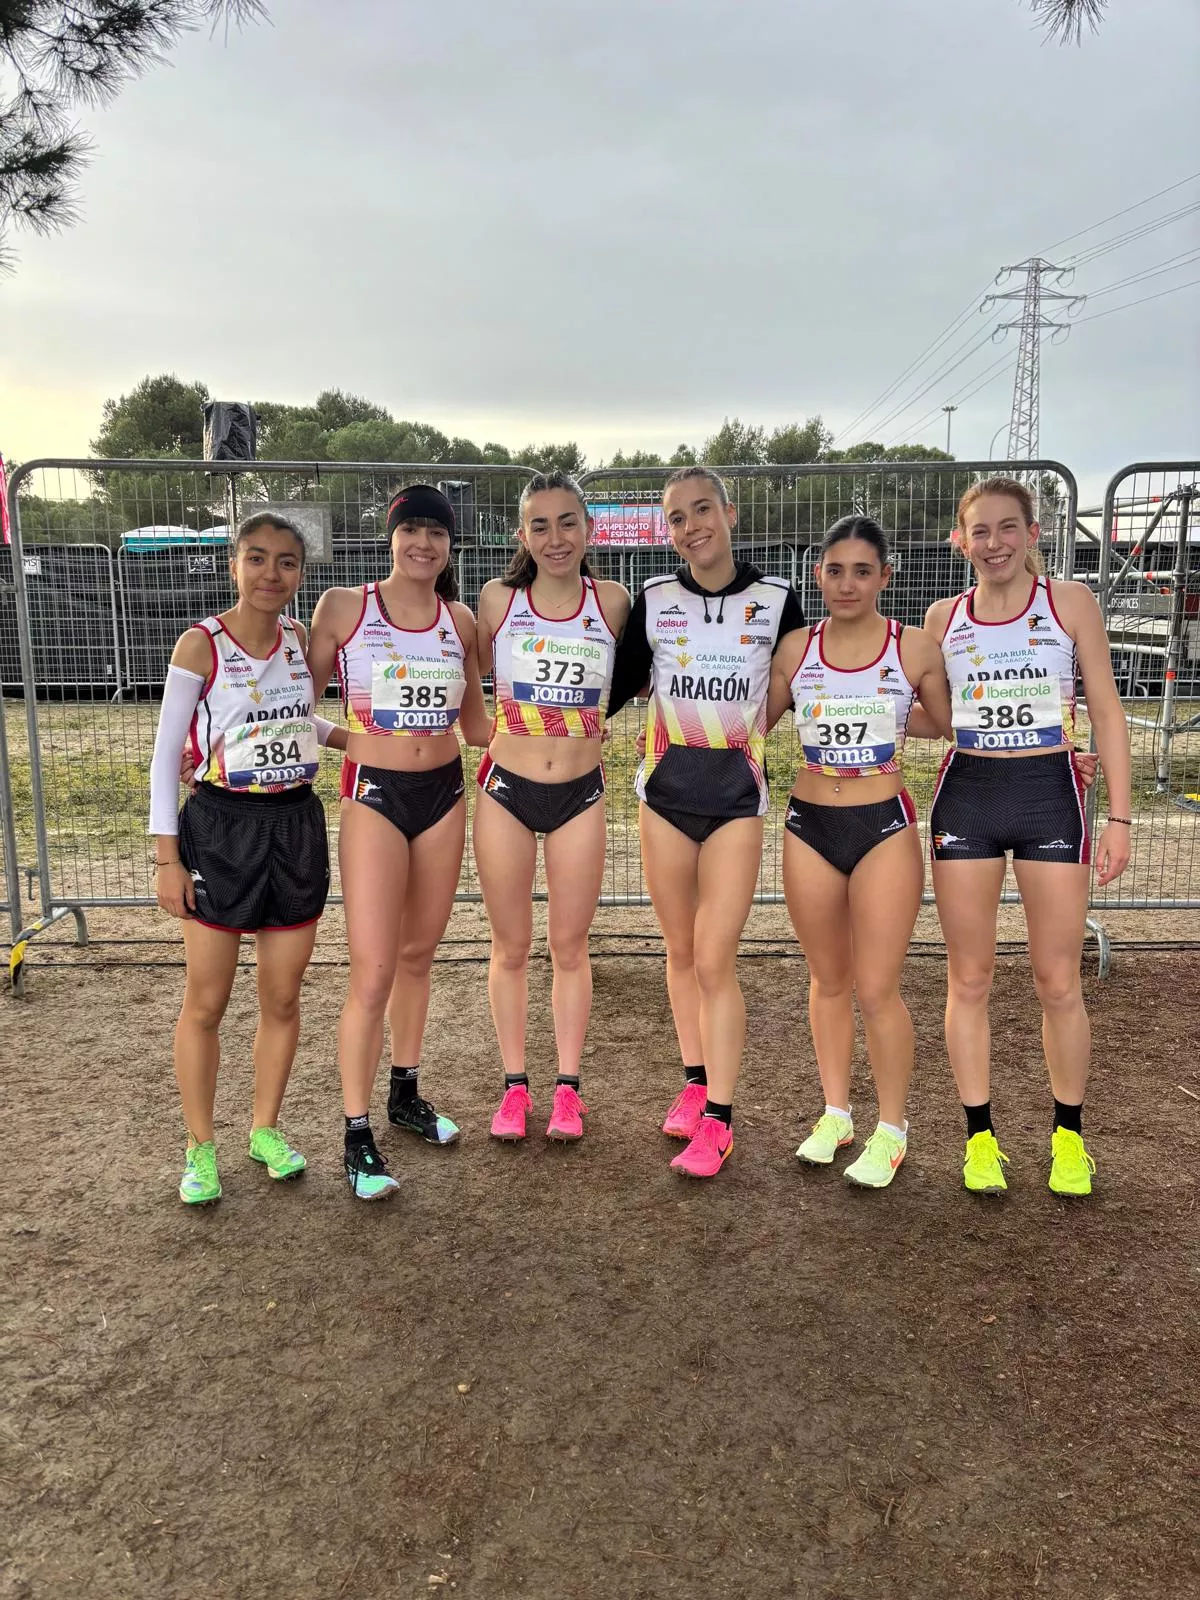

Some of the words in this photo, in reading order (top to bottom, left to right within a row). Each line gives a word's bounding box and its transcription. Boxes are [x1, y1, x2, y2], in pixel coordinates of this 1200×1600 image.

[597, 523, 649, 531] CAMPEONATO
[610, 530, 639, 538] ESPAÑA
[656, 618, 688, 628] belsue
[406, 654, 425, 662] CAJA
[547, 641, 600, 660] Iberdrola
[988, 651, 1008, 660] CAJA
[1010, 649, 1038, 657] RURAL
[409, 667, 460, 680] Iberdrola
[536, 659, 586, 686] 373
[265, 688, 281, 696] CAJA
[282, 685, 305, 694] RURAL
[669, 672, 750, 702] ARAGÓN
[987, 683, 1051, 699] Iberdrola
[399, 686, 448, 708] 385
[825, 702, 886, 717] Iberdrola
[978, 704, 1034, 729] 386
[262, 721, 312, 737] Iberdrola
[816, 722, 868, 746] 387
[254, 740, 301, 767] 384
